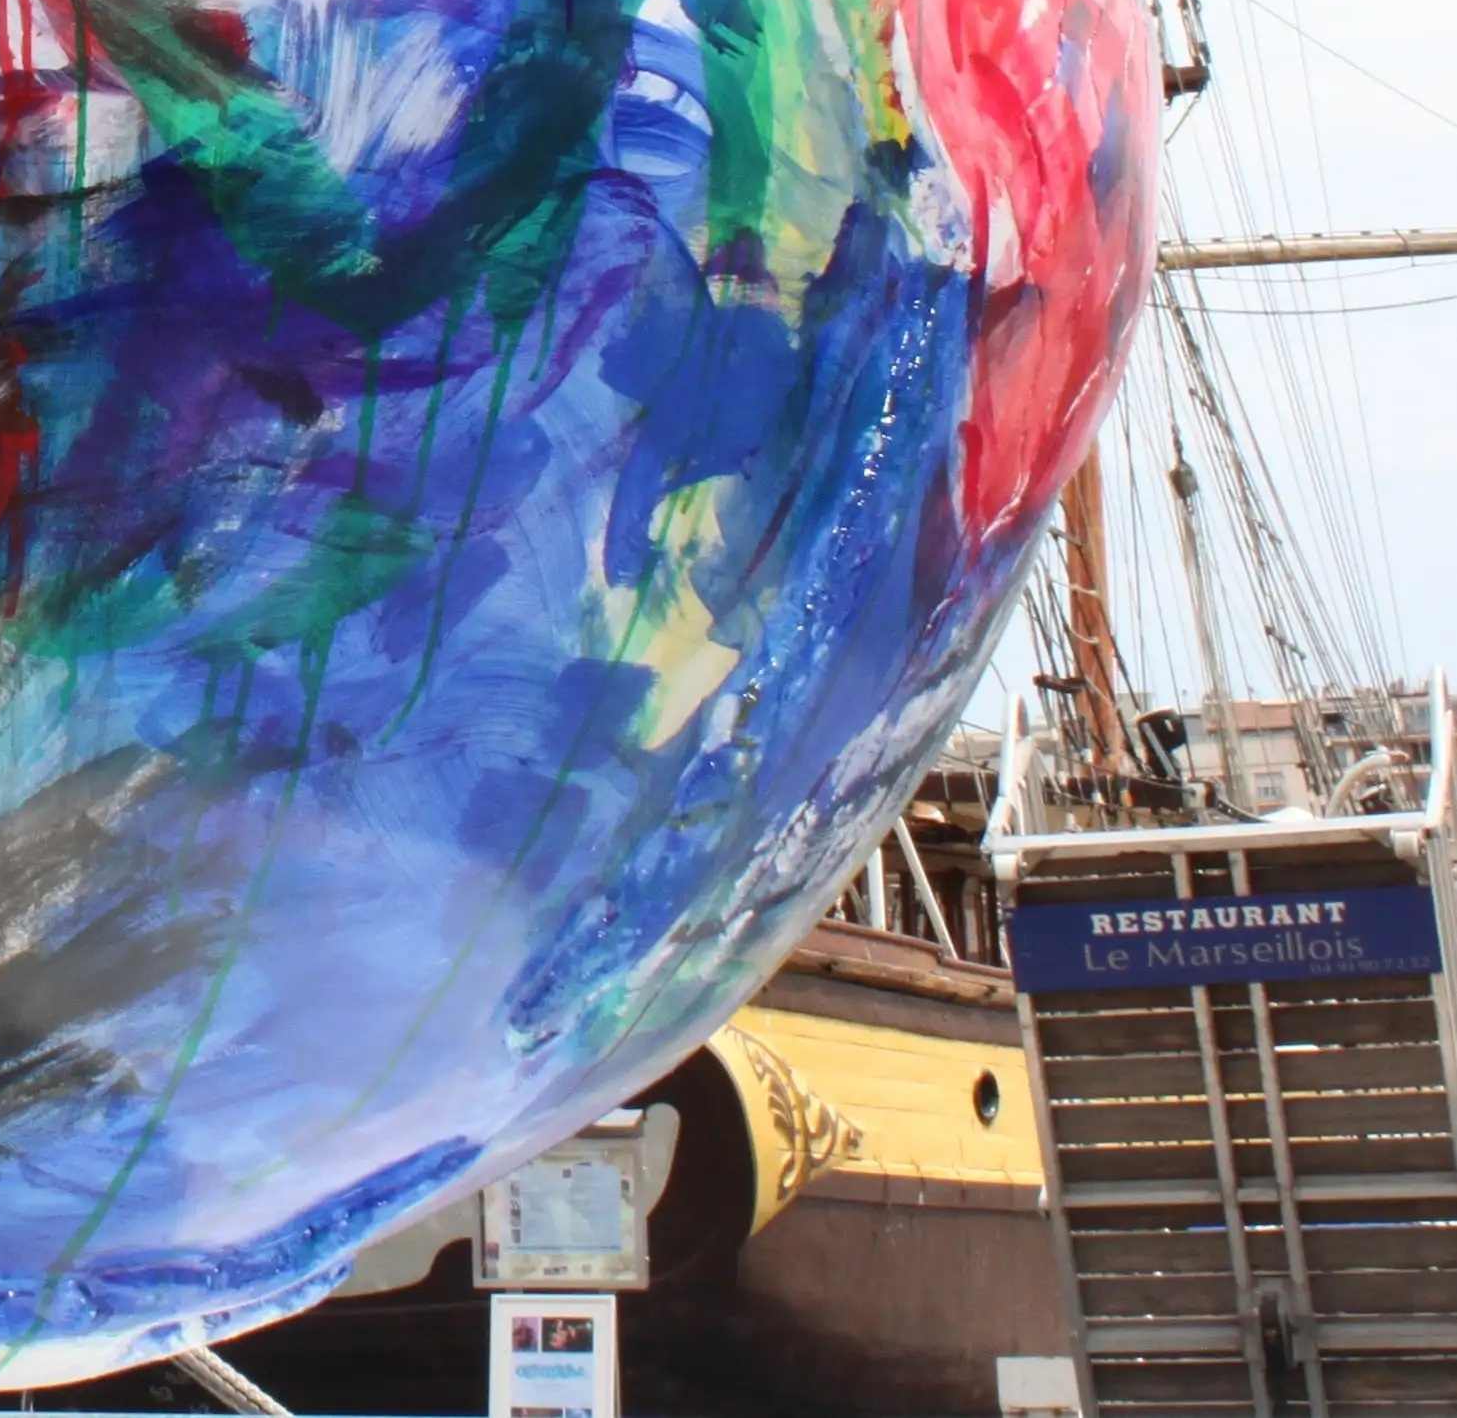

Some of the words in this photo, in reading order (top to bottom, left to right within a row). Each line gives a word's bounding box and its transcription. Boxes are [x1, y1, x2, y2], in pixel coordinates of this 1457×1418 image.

[1090, 901, 1345, 935] RESTAURANT
[1084, 943, 1129, 972] Le
[1147, 931, 1364, 967] Marseillois
